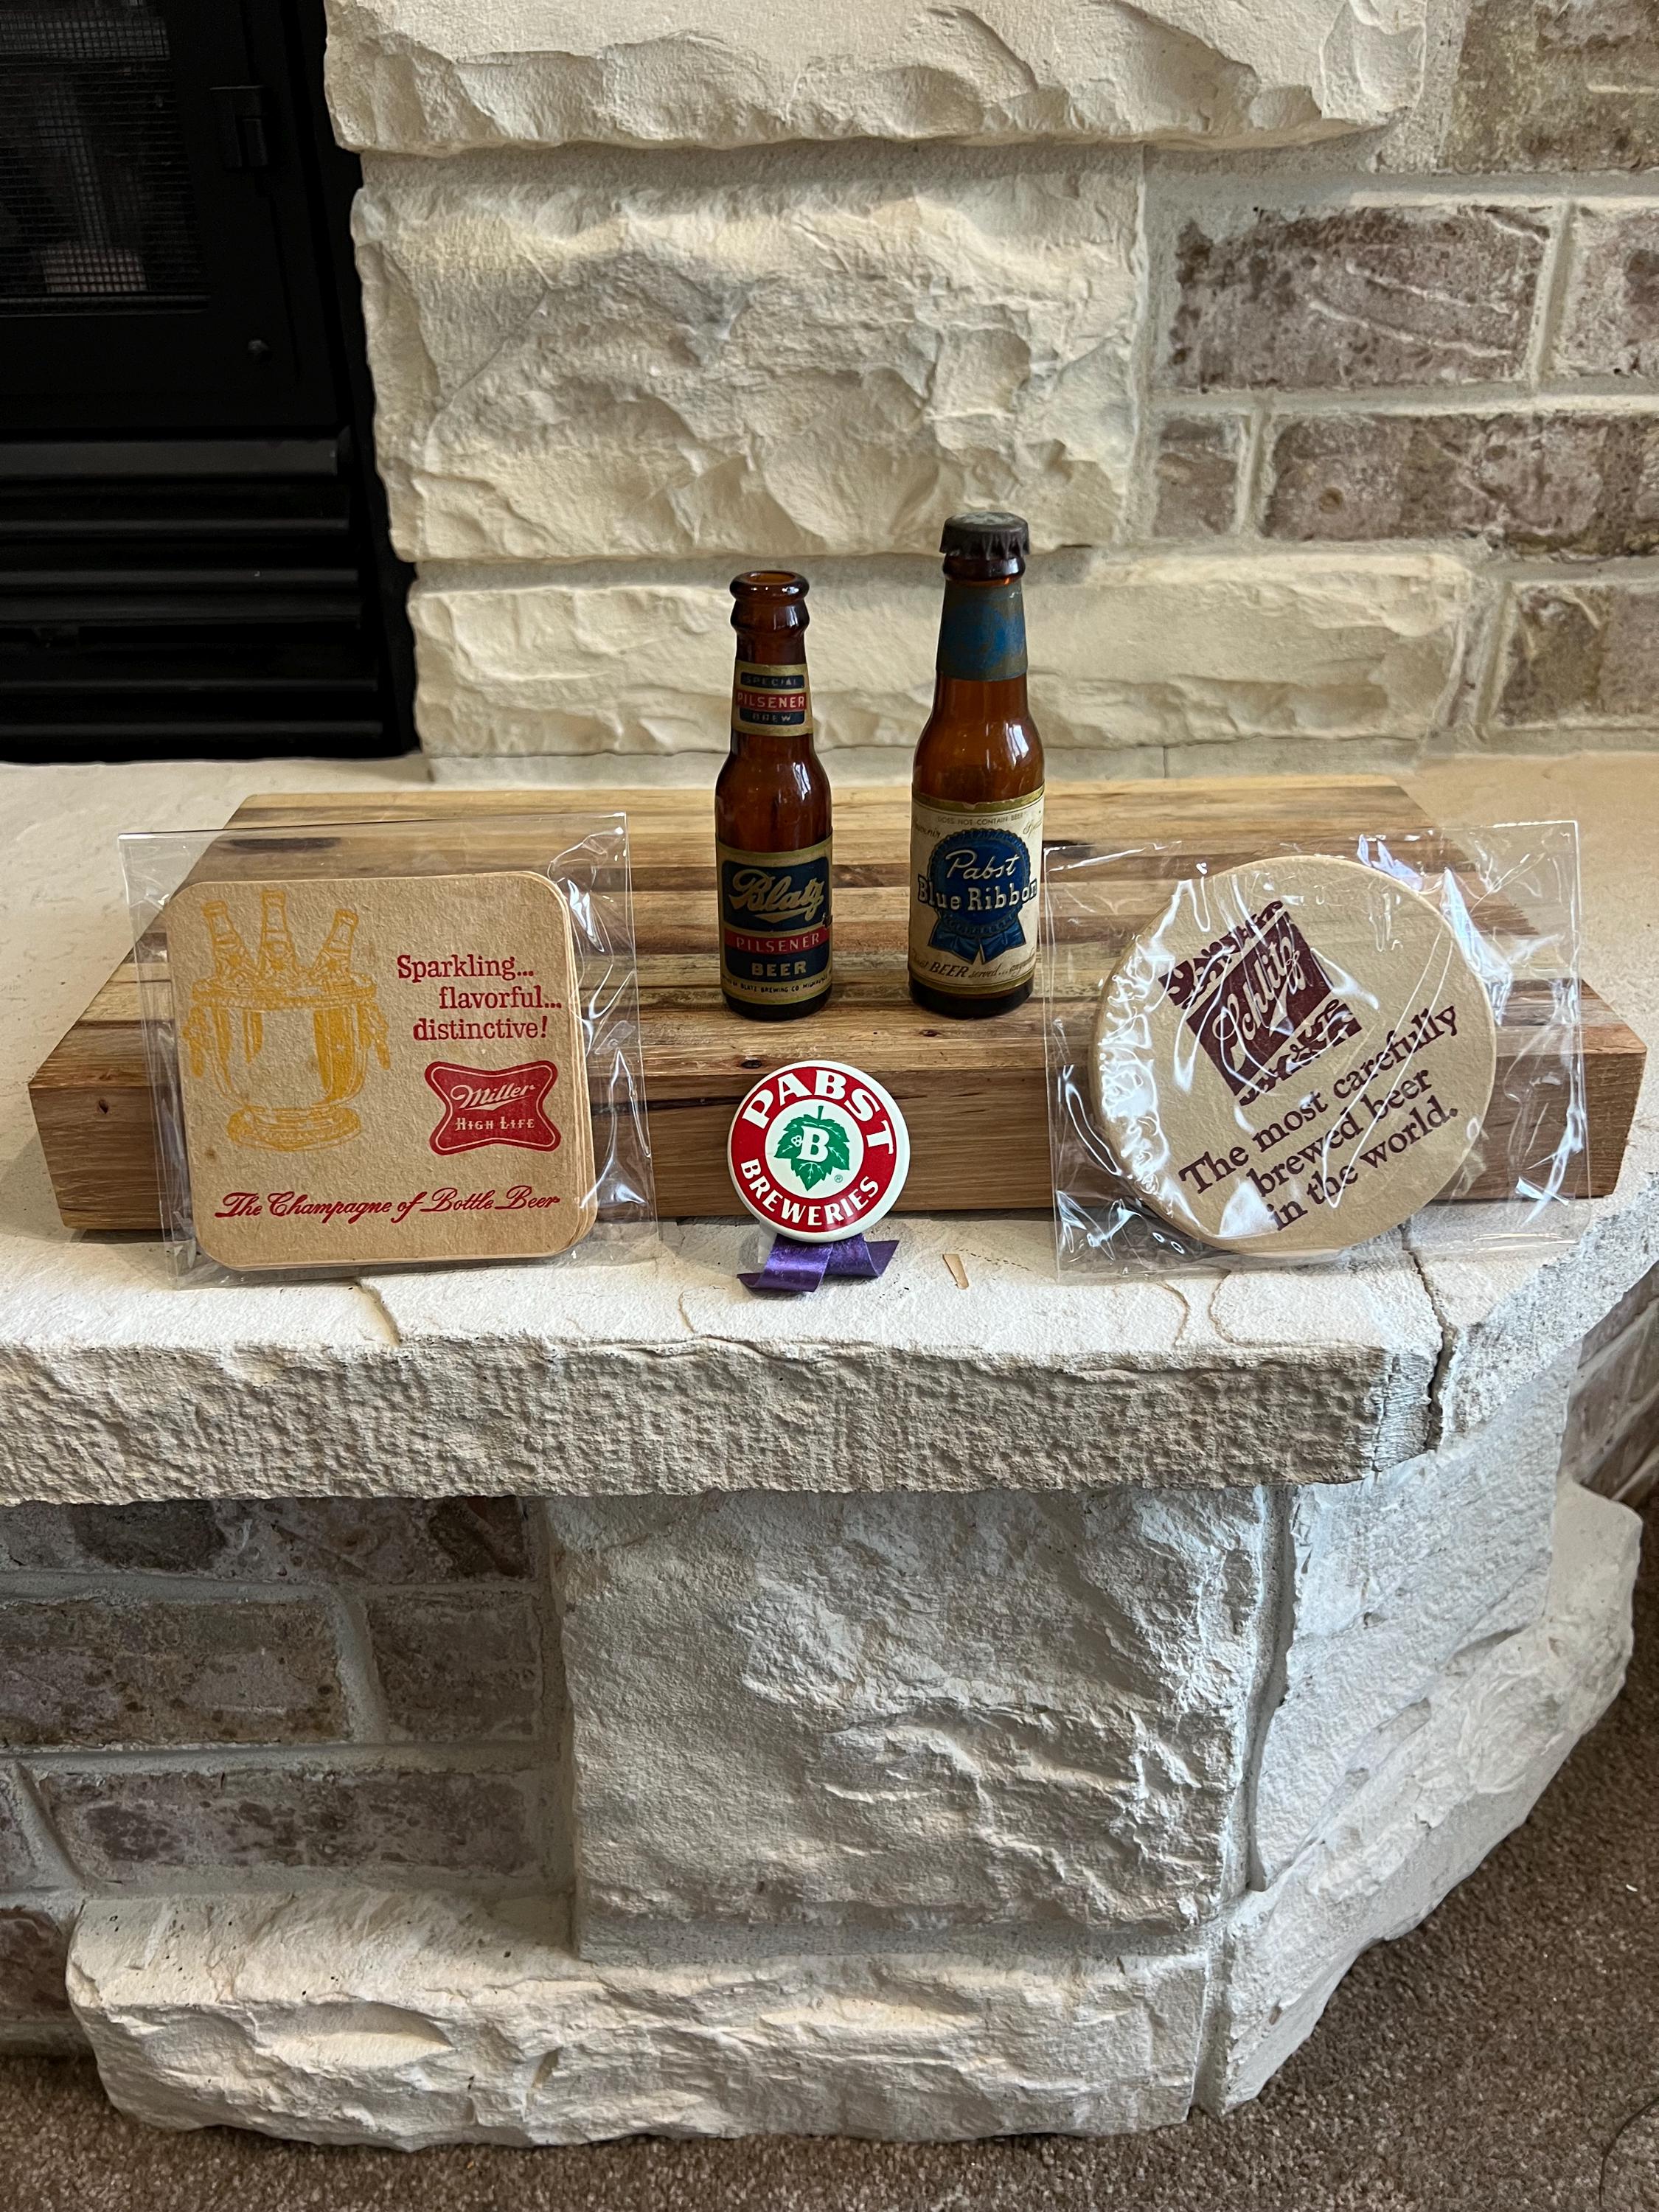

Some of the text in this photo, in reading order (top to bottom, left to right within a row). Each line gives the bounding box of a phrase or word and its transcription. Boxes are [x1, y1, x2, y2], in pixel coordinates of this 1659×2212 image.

[737, 691, 805, 709] PILSENER
[751, 712, 792, 723] BREW
[976, 816, 1009, 826] CONTAIN
[945, 849, 1020, 880] Pabst
[728, 868, 825, 922] Blatz
[918, 874, 1037, 911] Blue Ribbon
[736, 933, 820, 953] PILSENER
[396, 953, 535, 984] Sparkling...
[751, 960, 807, 978] BEER
[928, 961, 970, 978] BEER
[439, 984, 563, 1009] flavorful...
[1211, 935, 1307, 1073] Schlitz
[412, 1015, 549, 1041] distinctive!
[450, 1082, 537, 1110] Miller
[741, 1068, 894, 1155] PABST
[1178, 1004, 1458, 1195] The most carefully
[454, 1116, 535, 1132] HIGH LIFE
[1245, 1068, 1433, 1197] brewed beer
[796, 1124, 830, 1163] B
[1266, 1094, 1459, 1231] in the world.
[215, 1184, 561, 1225] The Champagne of Bottle Beer
[740, 1158, 880, 1227] BREWERIES
